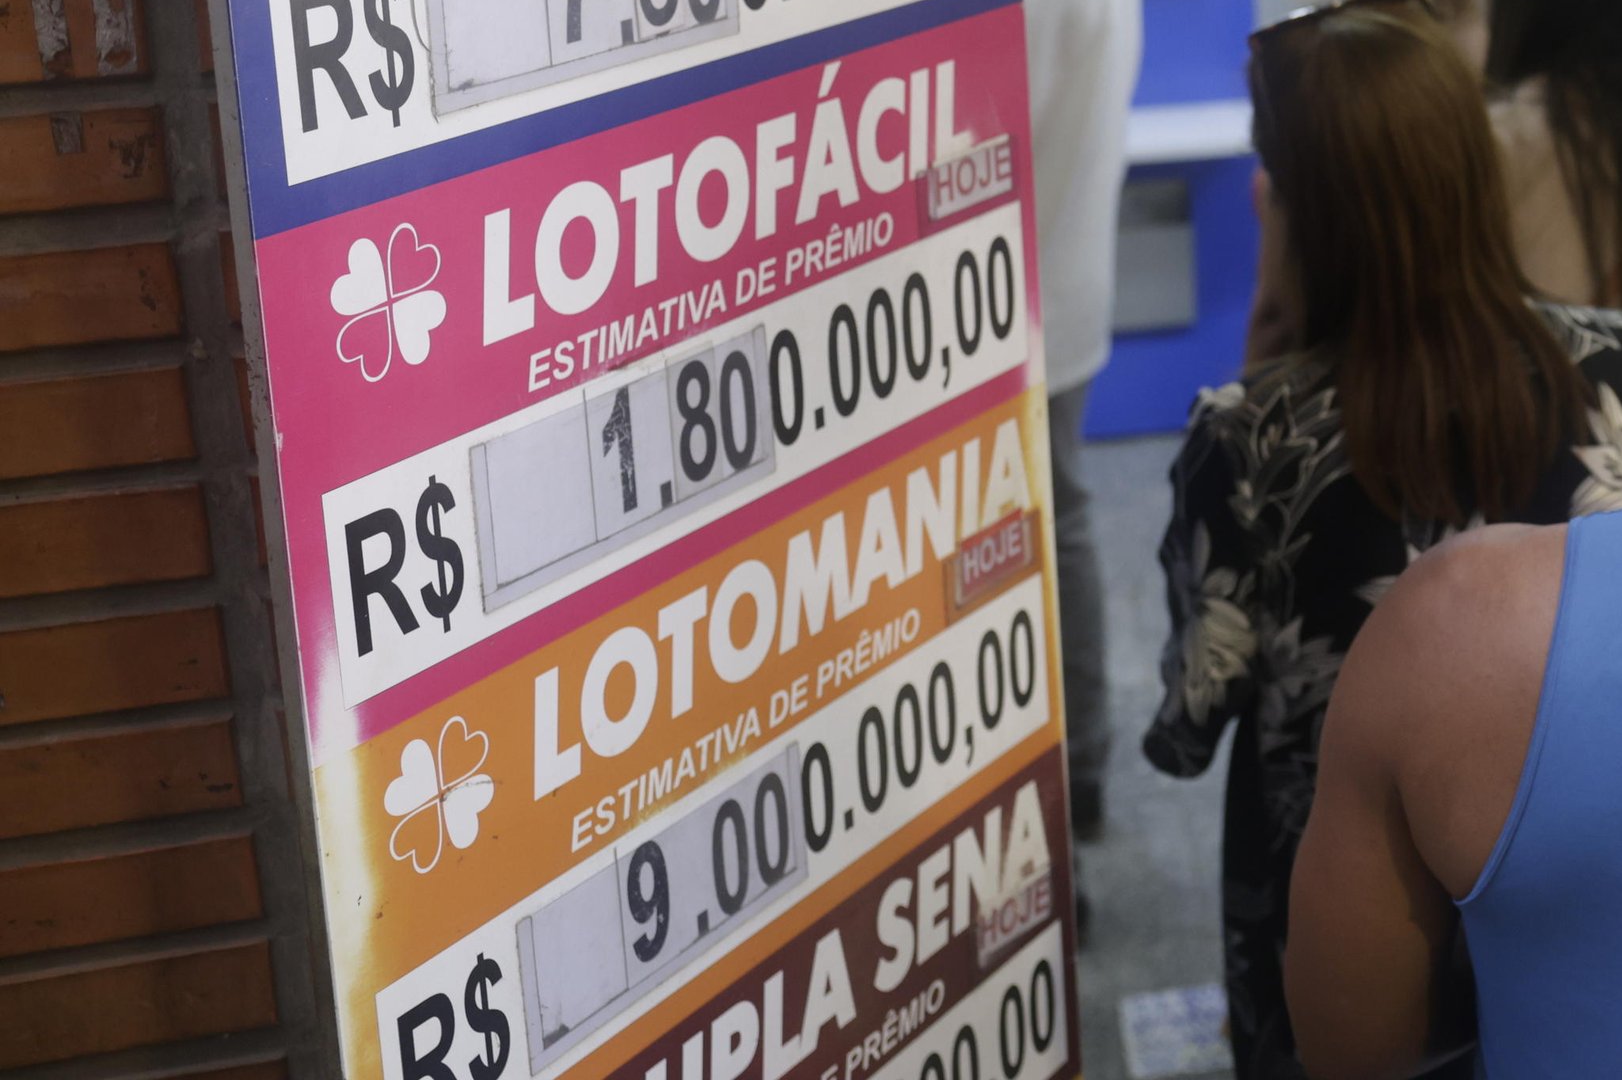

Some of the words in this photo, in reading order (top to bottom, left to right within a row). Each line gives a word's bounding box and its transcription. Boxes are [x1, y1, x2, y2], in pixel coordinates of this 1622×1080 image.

[484, 60, 973, 346] LOTOFÁCIL
[935, 143, 1012, 207] HOJE
[528, 280, 727, 393] ESTIMATIVA
[735, 258, 777, 308] DE
[785, 211, 894, 290] PRÊMIO
[345, 475, 466, 658] R$
[602, 234, 1015, 514] 1.800.000,00
[963, 520, 1022, 584] HOJE
[534, 417, 1032, 801] LOTOMANIA
[397, 952, 511, 1080] R$
[626, 608, 1037, 963] 9.000.000,00
[571, 709, 760, 853] ESTIMATIVA
[769, 678, 808, 731] DE
[815, 610, 921, 694] PRÊMIO
[645, 928, 857, 1080] PLA
[874, 779, 1051, 993] SENA
[843, 978, 946, 1080] PRÊMIO
[980, 877, 1050, 950] HOJE
